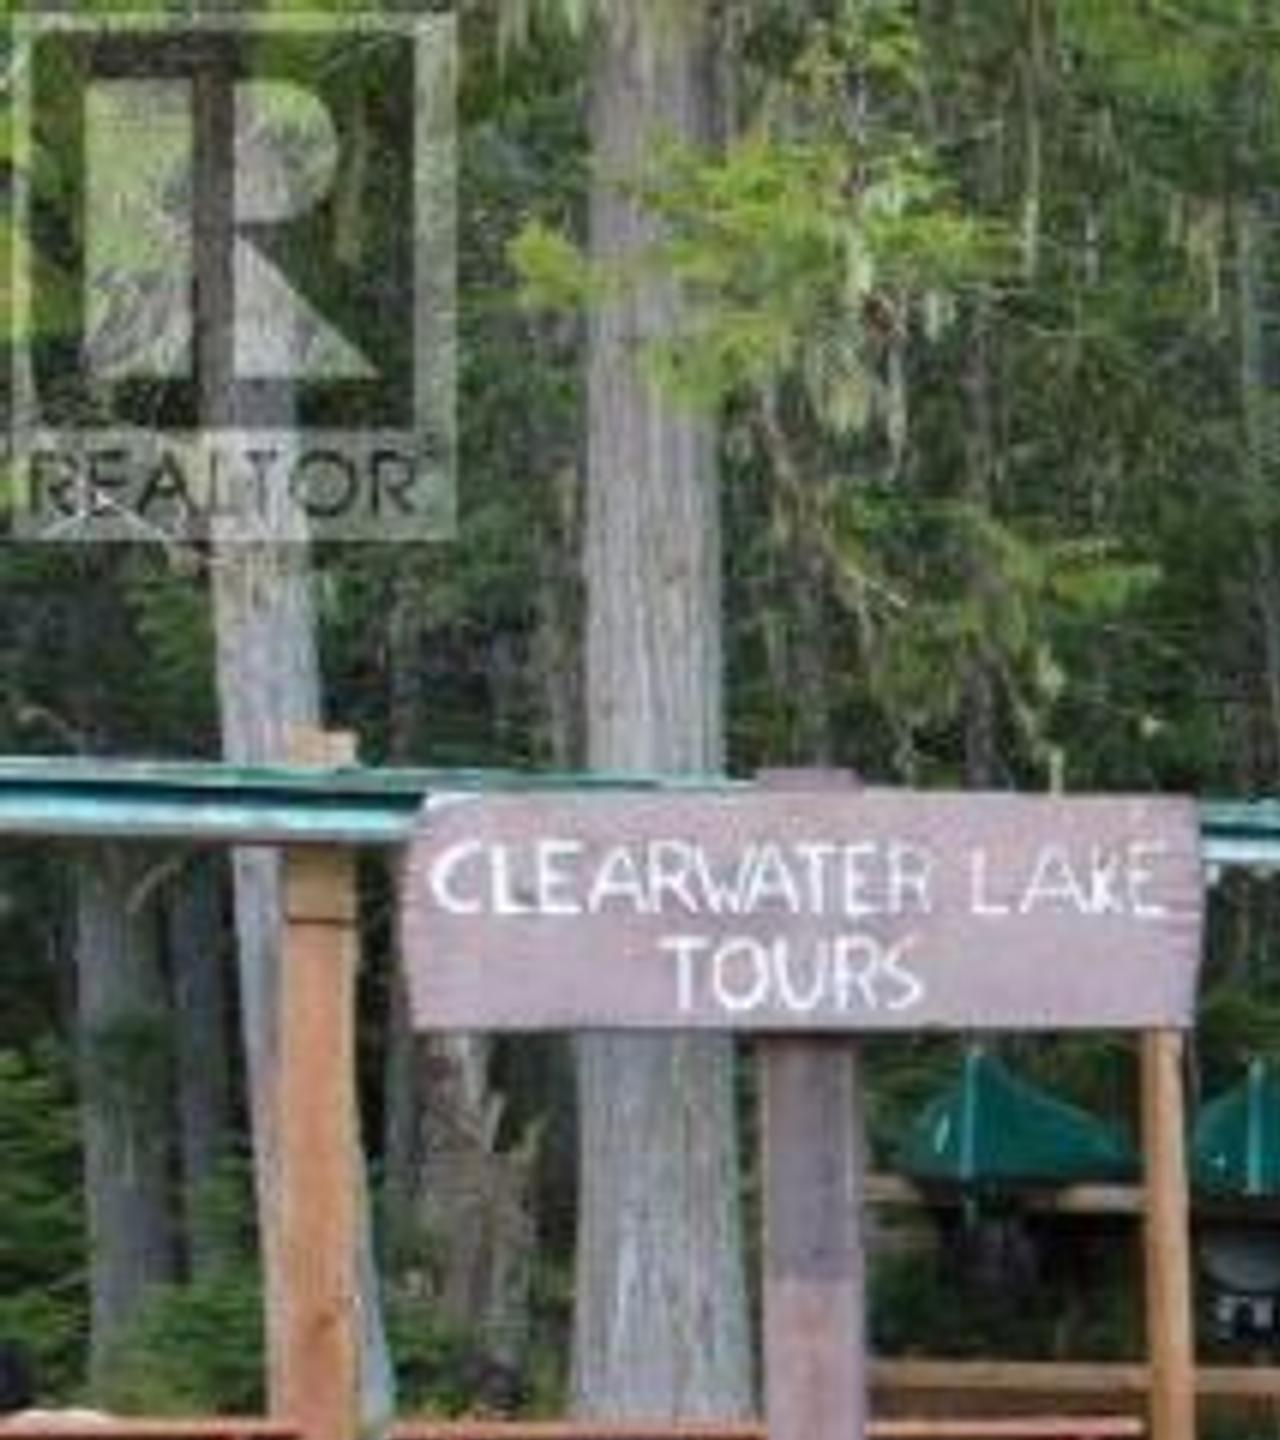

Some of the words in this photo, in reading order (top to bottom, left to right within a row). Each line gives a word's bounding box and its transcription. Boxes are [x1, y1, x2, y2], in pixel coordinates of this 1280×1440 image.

[429, 837, 936, 917] CLEARWATER
[970, 838, 1170, 920] LAKE
[655, 931, 926, 1013] TOURS
